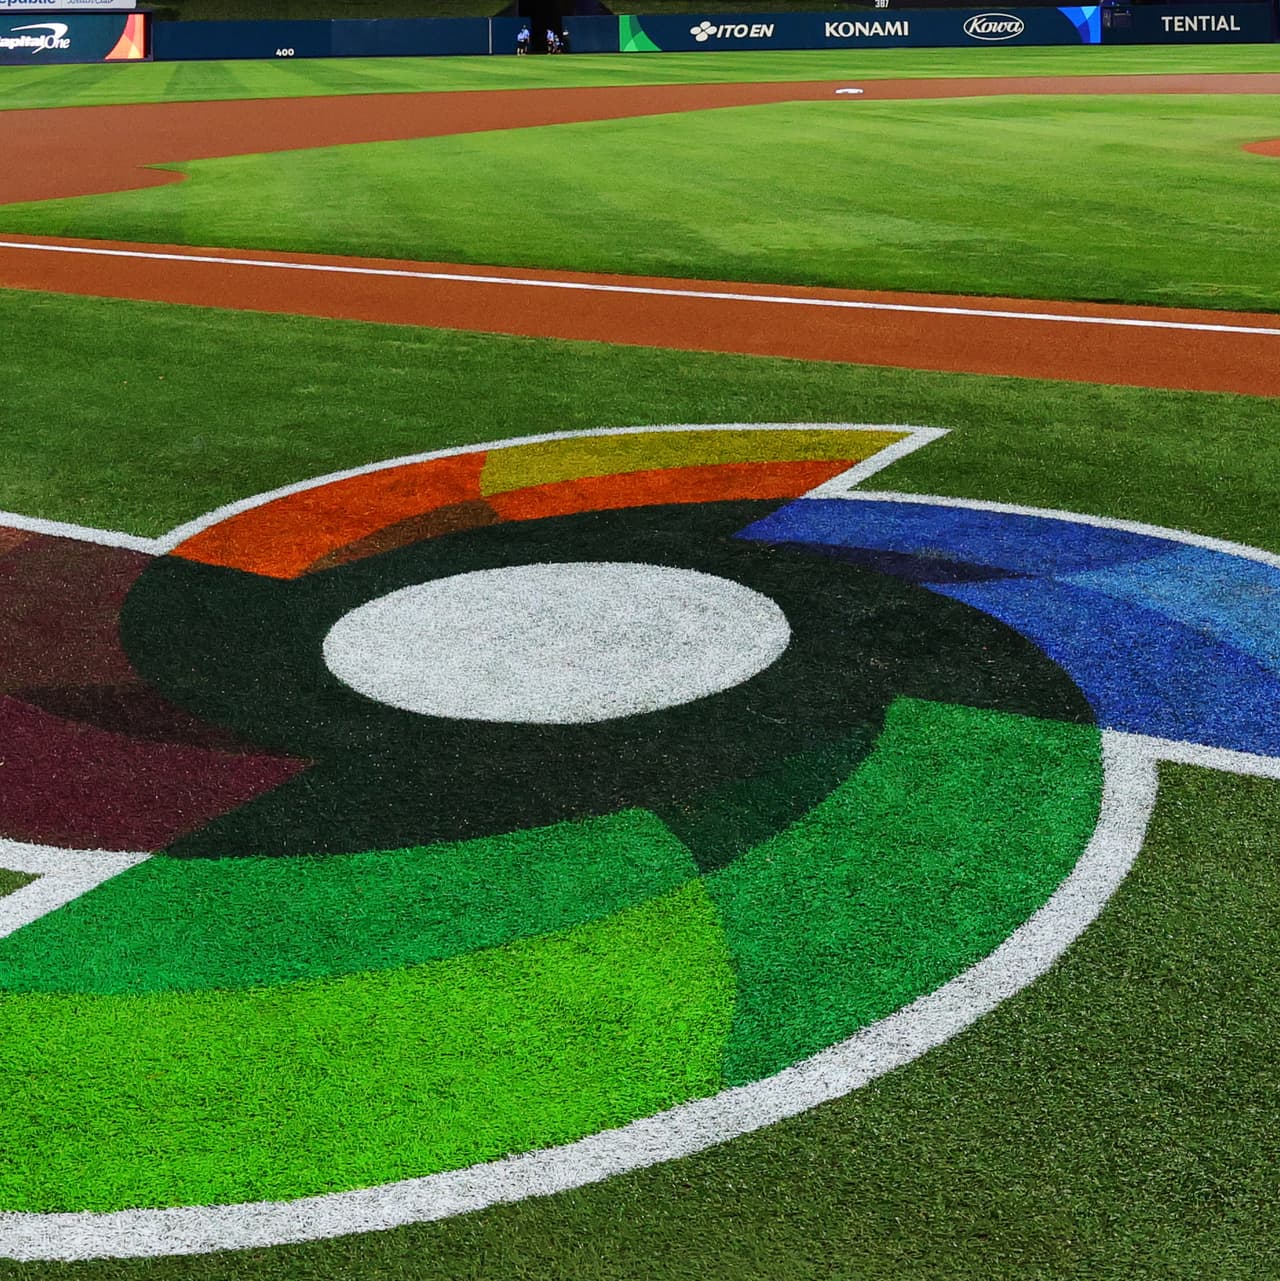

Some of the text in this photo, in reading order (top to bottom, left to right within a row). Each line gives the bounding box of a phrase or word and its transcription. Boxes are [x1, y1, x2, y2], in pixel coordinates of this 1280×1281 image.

[874, 0, 889, 8] 387
[717, 23, 775, 38] ITO EN
[825, 21, 909, 37] KONAMI
[968, 17, 1022, 34] Kowa
[1161, 15, 1241, 32] TENTIAL
[275, 48, 295, 57] 400
